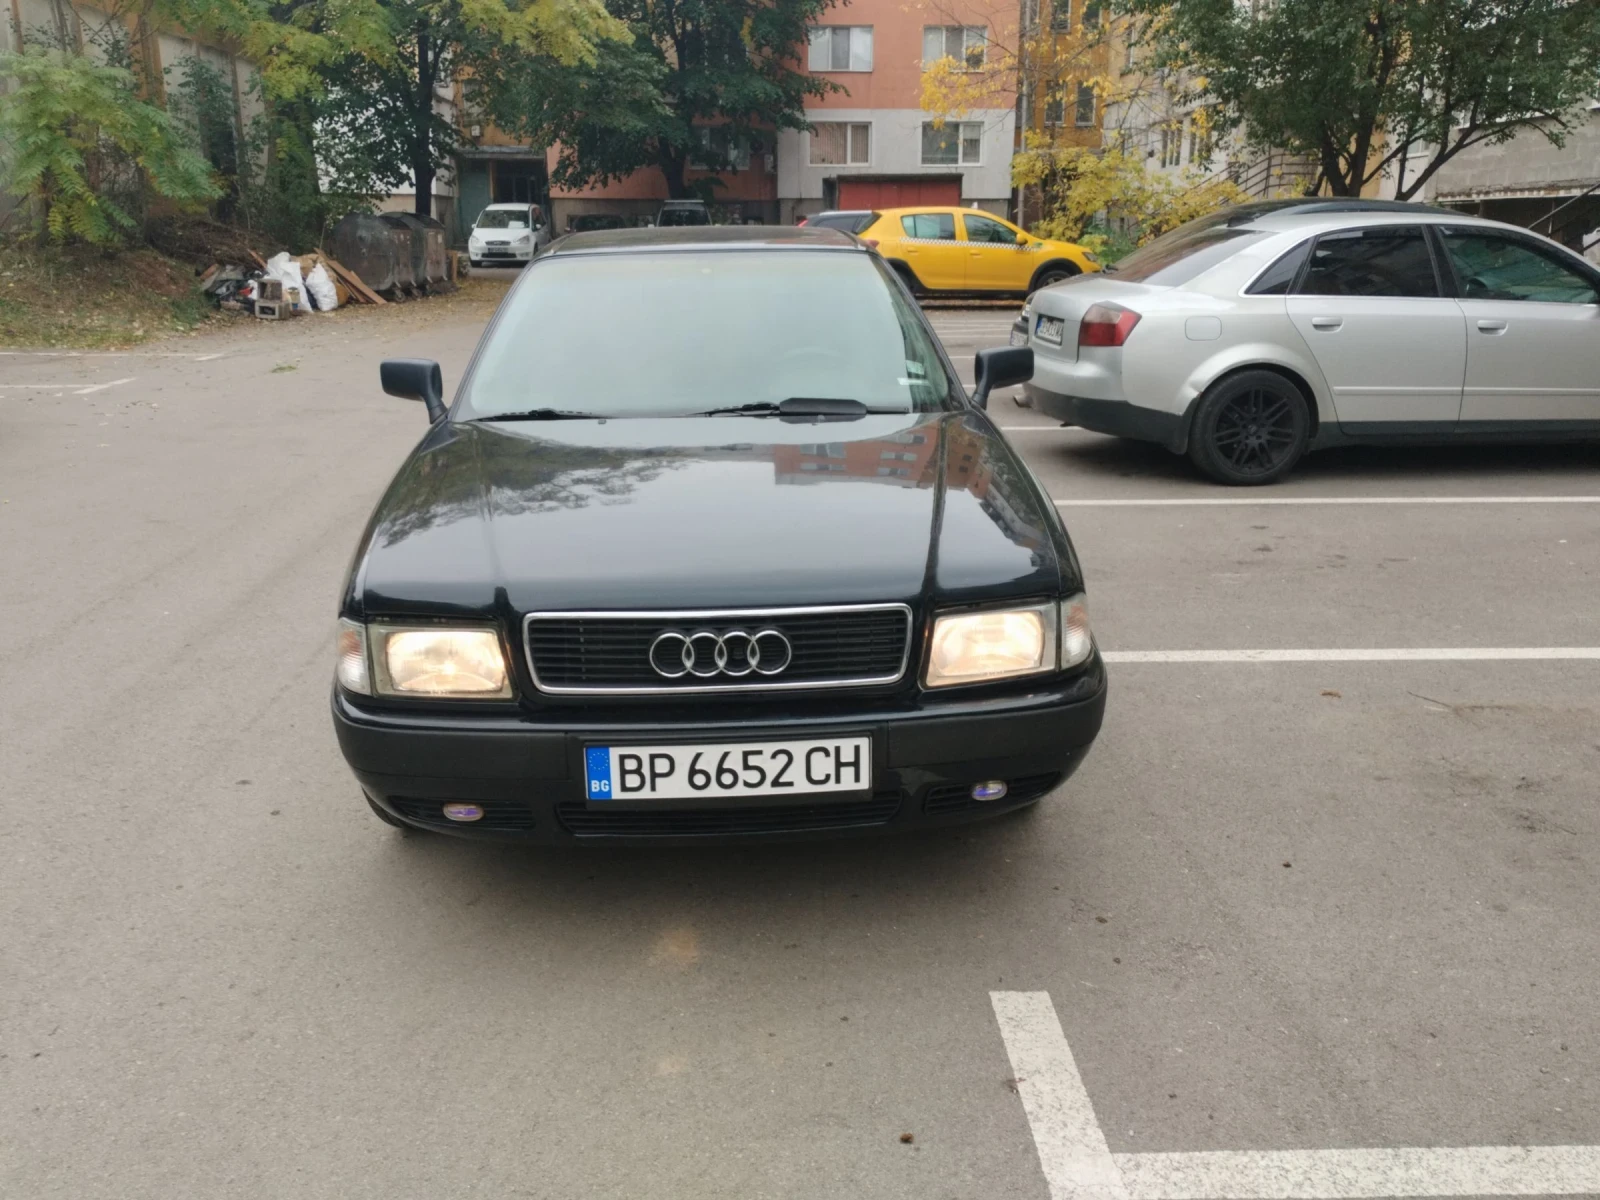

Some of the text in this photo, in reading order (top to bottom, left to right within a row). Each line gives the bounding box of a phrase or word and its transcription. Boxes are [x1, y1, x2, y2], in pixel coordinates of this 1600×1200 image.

[618, 744, 861, 792] BP 6652 CH
[591, 780, 610, 792] BG
